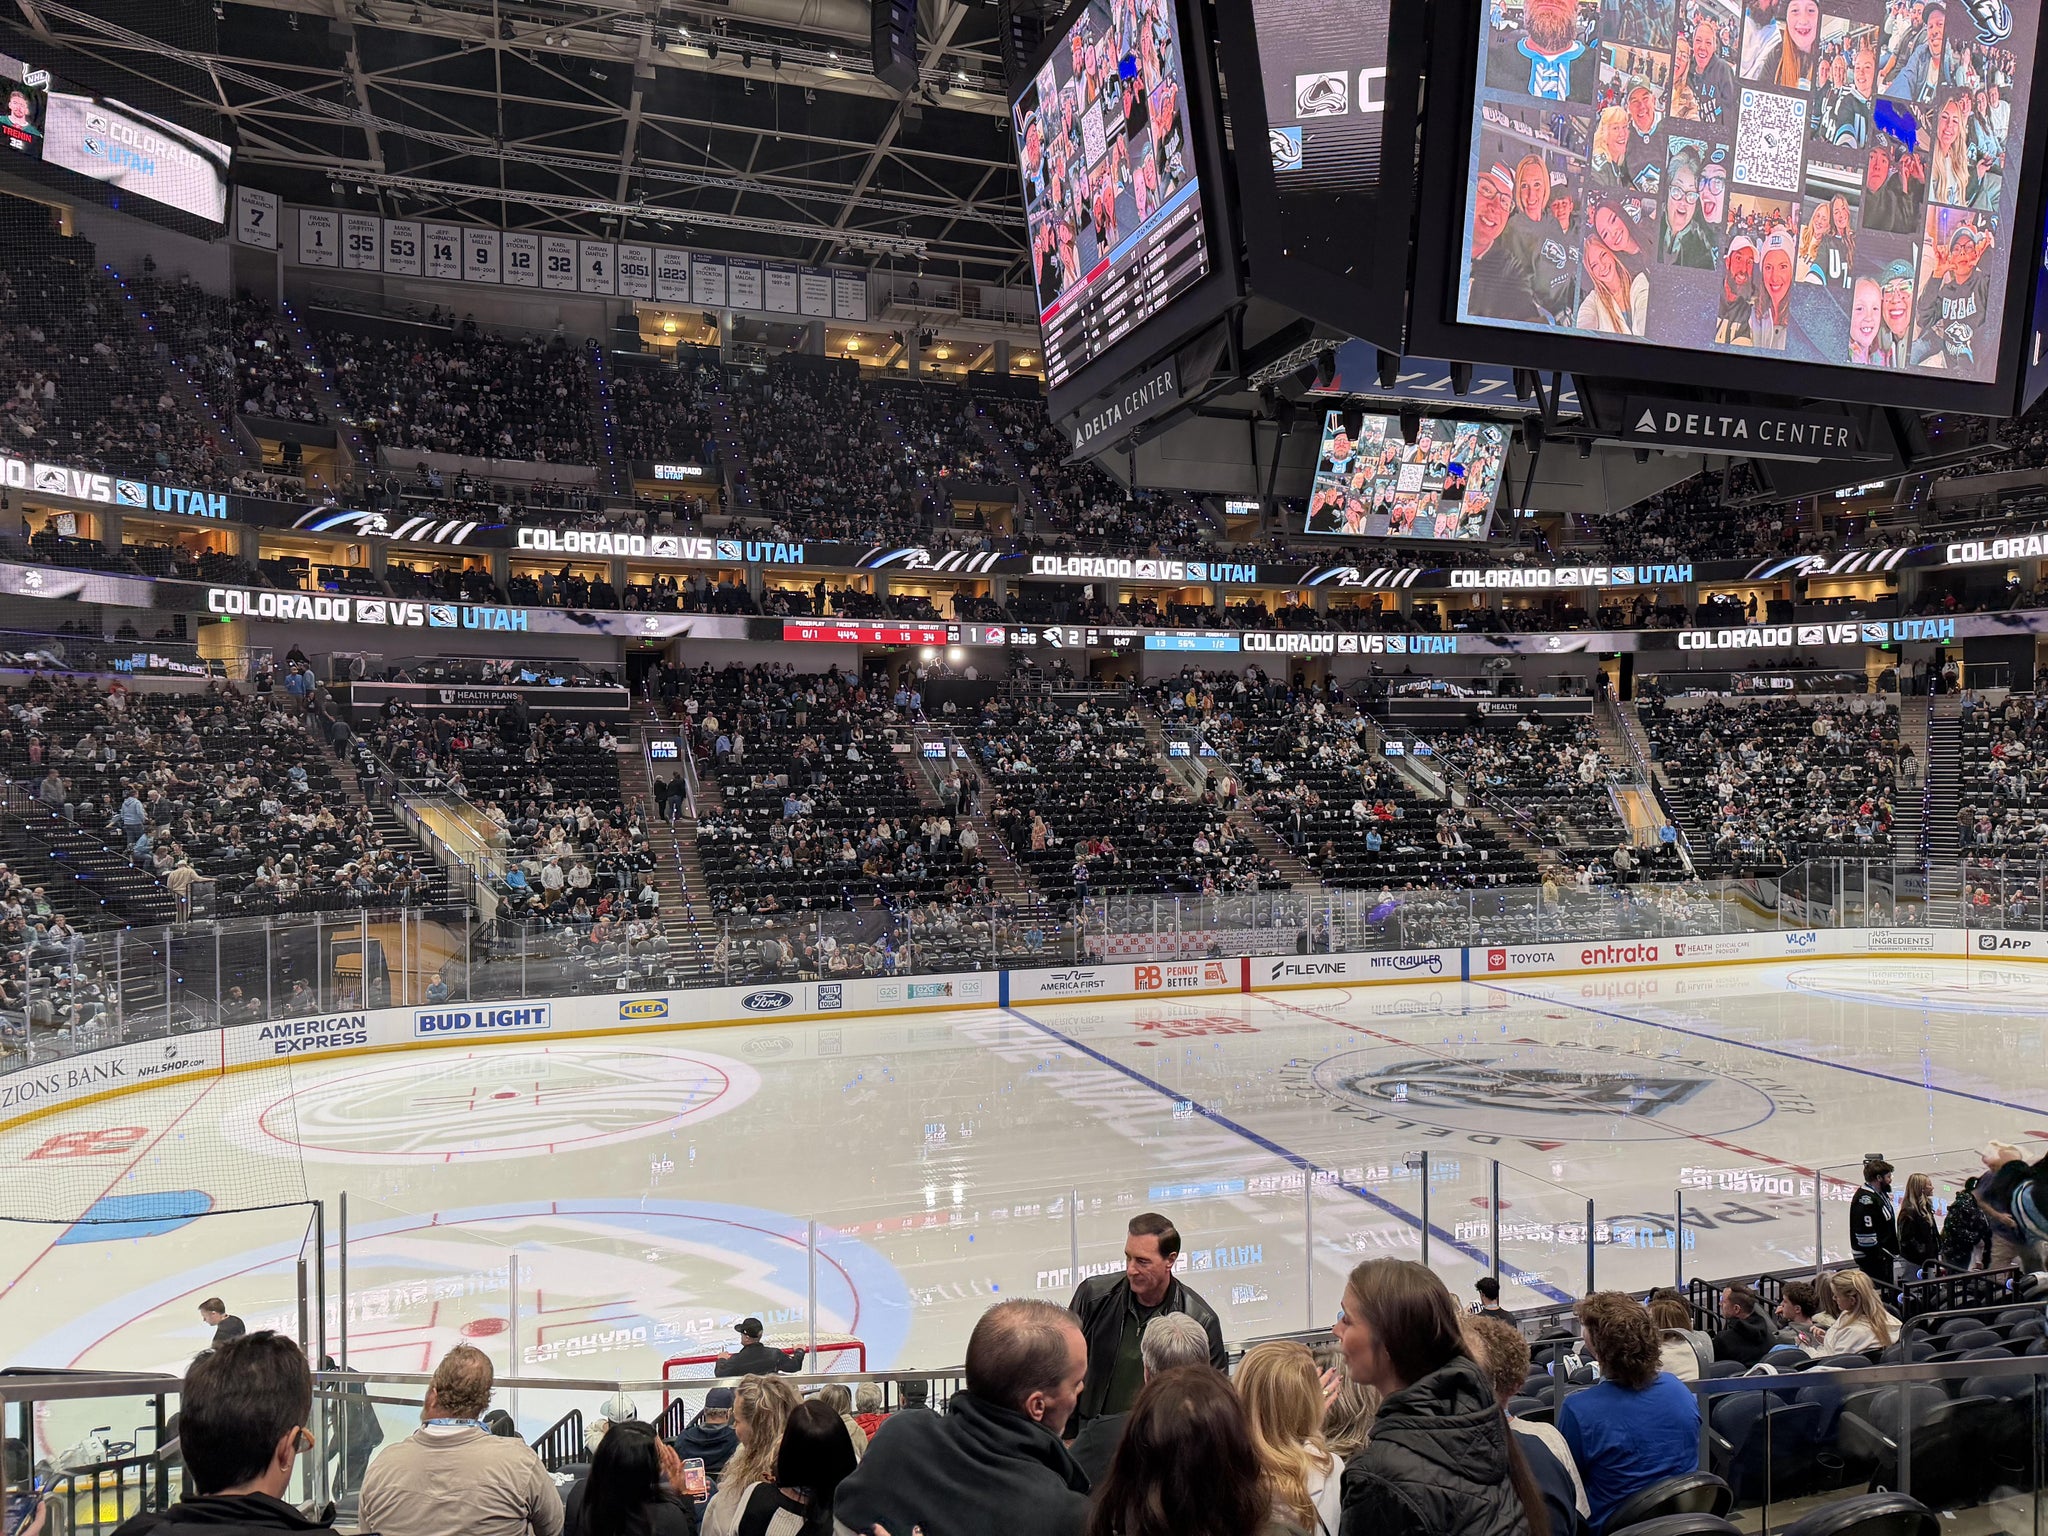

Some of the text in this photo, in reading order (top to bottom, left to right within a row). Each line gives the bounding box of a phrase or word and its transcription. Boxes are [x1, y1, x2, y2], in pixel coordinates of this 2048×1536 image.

[27, 72, 47, 84] NHL
[2, 125, 32, 144] TRENIN
[10, 138, 23, 150] 32
[109, 122, 200, 170] COLORADO
[108, 145, 156, 177] UTAH
[251, 208, 265, 227] 7
[309, 214, 329, 223] FRANK
[307, 221, 331, 229] LAYDEN
[394, 224, 412, 232] MARK
[315, 230, 323, 247] 1
[392, 230, 413, 238] EATON
[427, 235, 458, 243] HORNACEK
[469, 232, 487, 240] LARRY
[349, 234, 374, 252] 35
[471, 238, 492, 246] MILLER
[506, 242, 536, 251] STOCKTON
[512, 237, 529, 245] JOHN
[551, 241, 567, 249] KARL
[390, 239, 415, 257] 53
[433, 243, 453, 261] 14
[547, 247, 571, 255] MALONE
[587, 245, 608, 253] ADRIAN
[476, 248, 489, 265] 9
[511, 251, 531, 269] 12
[585, 250, 609, 259] DANTLEY
[622, 254, 647, 262] HUNDLEY
[664, 253, 681, 261] JERRY
[548, 255, 571, 273] 32
[592, 260, 603, 277] 4
[663, 259, 681, 267] SLOAN
[702, 265, 717, 273] JOHN
[620, 263, 650, 277] 3051
[657, 267, 687, 281] 1223
[695, 269, 722, 278] STOCKTON
[734, 274, 756, 282] MALONE
[1942, 292, 1977, 320] UTAH
[1085, 371, 1173, 440] DELTA CENTER
[1664, 411, 1849, 448] DELTA CENTER
[664, 465, 703, 475] COLORADO
[664, 471, 684, 480] UTAH
[72, 471, 228, 519] VS UTAH
[518, 527, 805, 564] COLORADO VS UTAH
[1032, 555, 1256, 583] COLORADO VS UTAH
[1450, 564, 1693, 588] COLORADO VS UTAH
[208, 588, 528, 631] COLORADO VS UTAH
[801, 629, 818, 639] 0/1
[837, 630, 859, 640] 44%
[874, 631, 882, 641] 6
[900, 632, 911, 641] 15
[922, 632, 935, 642] 34
[947, 632, 960, 642] 20
[970, 627, 977, 643] 1
[1010, 632, 1037, 645] 9:26
[1068, 630, 1079, 645] 2
[1086, 635, 1099, 645] 25
[1678, 619, 1955, 651] COLORADO VS UTAH
[1113, 637, 1131, 647] 0:47
[1156, 639, 1166, 648] 13
[1177, 639, 1195, 648] 56%
[1211, 640, 1225, 649] 1/2
[1243, 633, 1457, 654] COLORADO VS UTAH
[457, 691, 518, 700] HEALTH PLANS
[366, 763, 375, 775] 9
[1871, 930, 1890, 938] JUST
[1871, 937, 1930, 945] INGREDIENTS
[1581, 943, 1659, 966] entrata
[1687, 944, 1713, 953] HEALTH
[1370, 954, 1443, 974] NITECRAWLER
[1510, 952, 1555, 964] TOYOTA
[1166, 965, 1199, 977] PEANUT
[1285, 962, 1346, 976] FILEVINE
[1134, 965, 1163, 991] PB
[1167, 976, 1199, 988] BETTER
[820, 986, 840, 995] BUILT
[917, 985, 935, 994] G2G
[961, 982, 980, 992] G2G
[1040, 979, 1105, 991] AMERICA FIRST
[1139, 980, 1148, 990] fit
[879, 987, 898, 996] G2G
[751, 991, 785, 1009] Ford
[820, 1000, 840, 1008] TOUGH
[624, 1003, 665, 1015] IKEA
[419, 1007, 546, 1033] BUD LIGHT
[257, 1015, 366, 1041] AMERICAN
[274, 1030, 368, 1055] EXPRESS
[1, 1058, 128, 1110] ZIONS BANK
[1331, 1104, 1502, 1145] DELTA
[1864, 1215, 1873, 1228] 9
